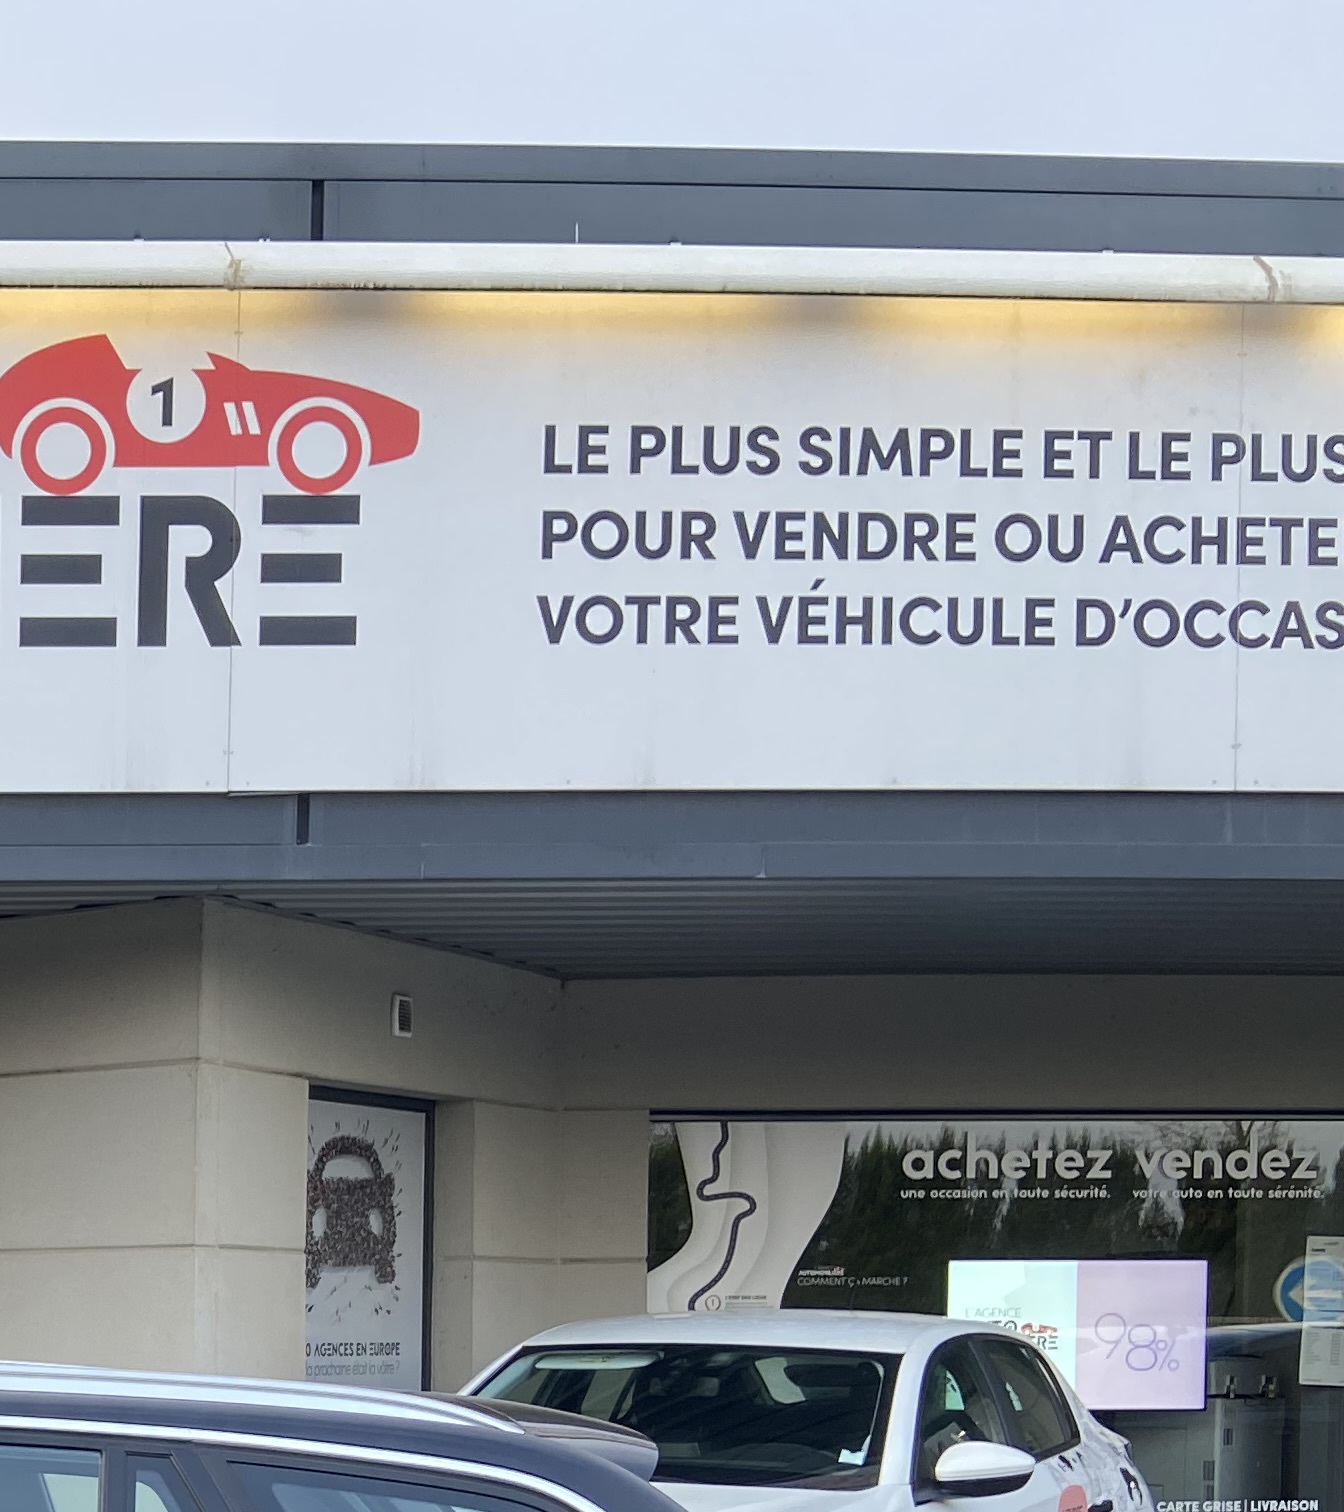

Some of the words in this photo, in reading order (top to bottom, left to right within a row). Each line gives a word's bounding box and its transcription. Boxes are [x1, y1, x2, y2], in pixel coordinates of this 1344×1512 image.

[149, 376, 175, 428] 1
[542, 424, 611, 476] LE
[628, 424, 782, 477] PLUS
[797, 426, 1025, 480] SIMPLE
[1042, 429, 1113, 480] ET
[1127, 430, 1192, 482] LE
[540, 510, 717, 561] POUR
[732, 511, 978, 562] VENDRE
[993, 513, 1086, 565] OU
[1098, 515, 1340, 567] ACHETE
[535, 594, 740, 646] VOTRE
[754, 579, 1057, 648] VÉHICULE
[1074, 597, 1344, 651] D'OCCAS
[901, 1130, 1113, 1180] achetez
[1133, 1130, 1318, 1180] vendez
[899, 1188, 926, 1199] une
[929, 1186, 988, 1199] occasion
[991, 1188, 1011, 1199] en
[1013, 1186, 1051, 1199] toute
[1054, 1184, 1112, 1200] sécurité.
[1132, 1186, 1169, 1199] votre
[1171, 1187, 1204, 1199] auto
[1206, 1188, 1224, 1199] en
[1227, 1186, 1264, 1199] toute
[1266, 1184, 1325, 1200] sérénité.
[313, 1342, 355, 1357] AGENCES
[356, 1342, 368, 1357] EN
[368, 1342, 401, 1357] EUROPE
[1156, 1500, 1200, 1512] CARTE
[1202, 1500, 1242, 1512] GRISE
[1250, 1499, 1319, 1512] LIVRAISON
